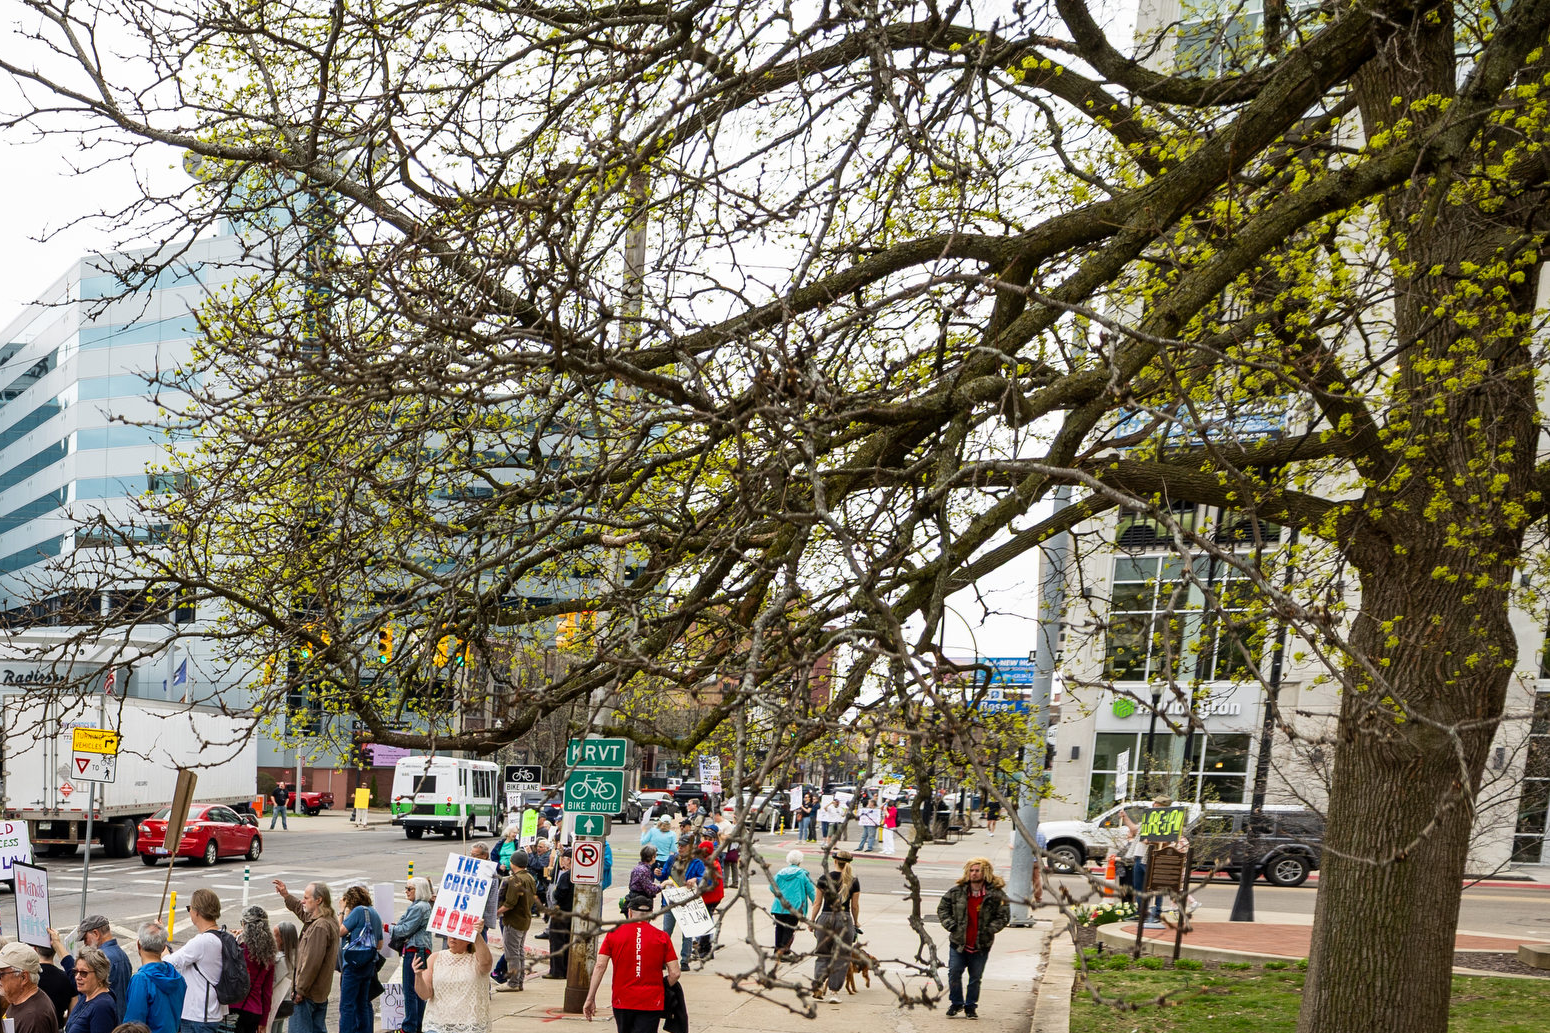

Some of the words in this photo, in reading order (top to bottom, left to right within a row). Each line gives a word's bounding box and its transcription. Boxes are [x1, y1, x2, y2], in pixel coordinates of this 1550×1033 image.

[572, 745, 620, 761] KRVT
[523, 783, 538, 791] LANE
[567, 801, 585, 809] BIKE
[591, 802, 617, 811] ROUTE
[457, 855, 481, 877] THE
[17, 871, 45, 898] Hands
[443, 873, 487, 897] CRISIS
[453, 893, 470, 911] IS
[431, 906, 480, 938] NOW
[689, 909, 709, 924] LAW
